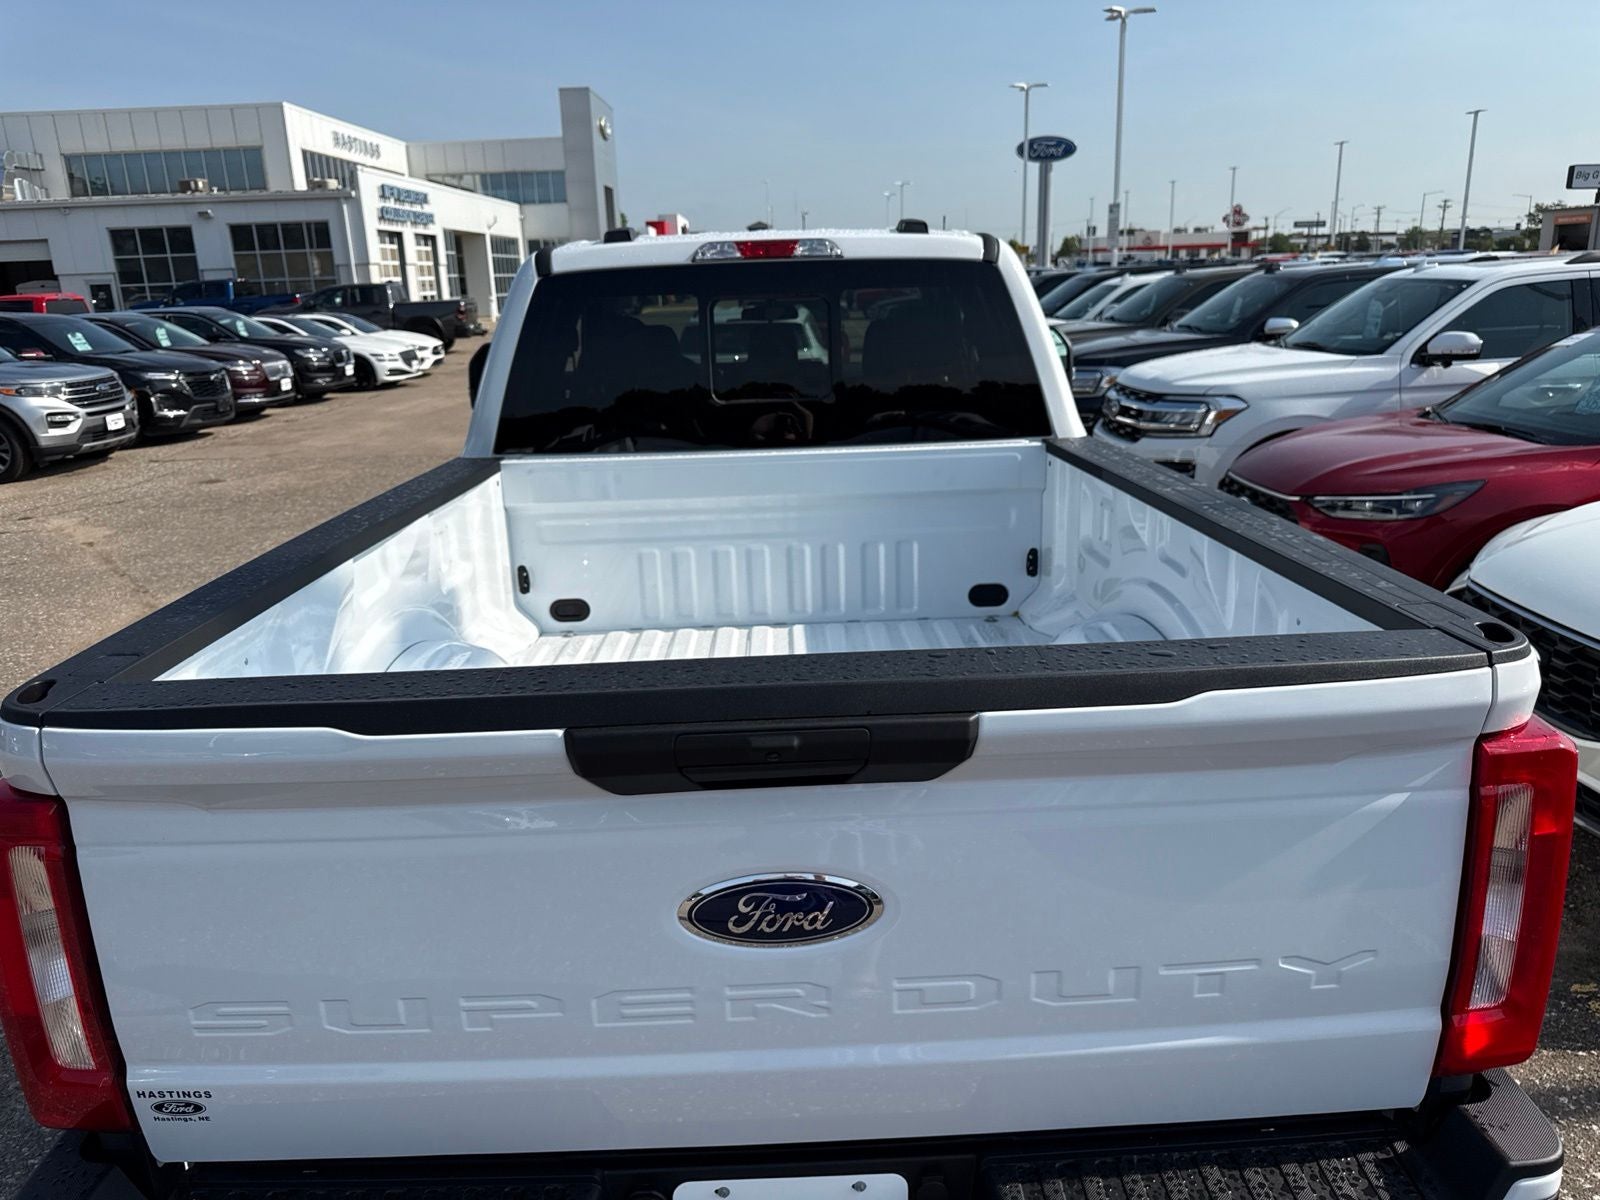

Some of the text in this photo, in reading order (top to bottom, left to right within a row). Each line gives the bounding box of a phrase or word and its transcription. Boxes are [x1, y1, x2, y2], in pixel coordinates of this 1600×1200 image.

[332, 131, 381, 159] HASTINGS
[1030, 141, 1065, 157] Ford
[1575, 170, 1590, 181] Big
[727, 892, 834, 933] Ford
[188, 949, 1378, 1037] SUPER DUTY
[136, 1090, 212, 1099] HASTINGS
[162, 1102, 195, 1113] Ford
